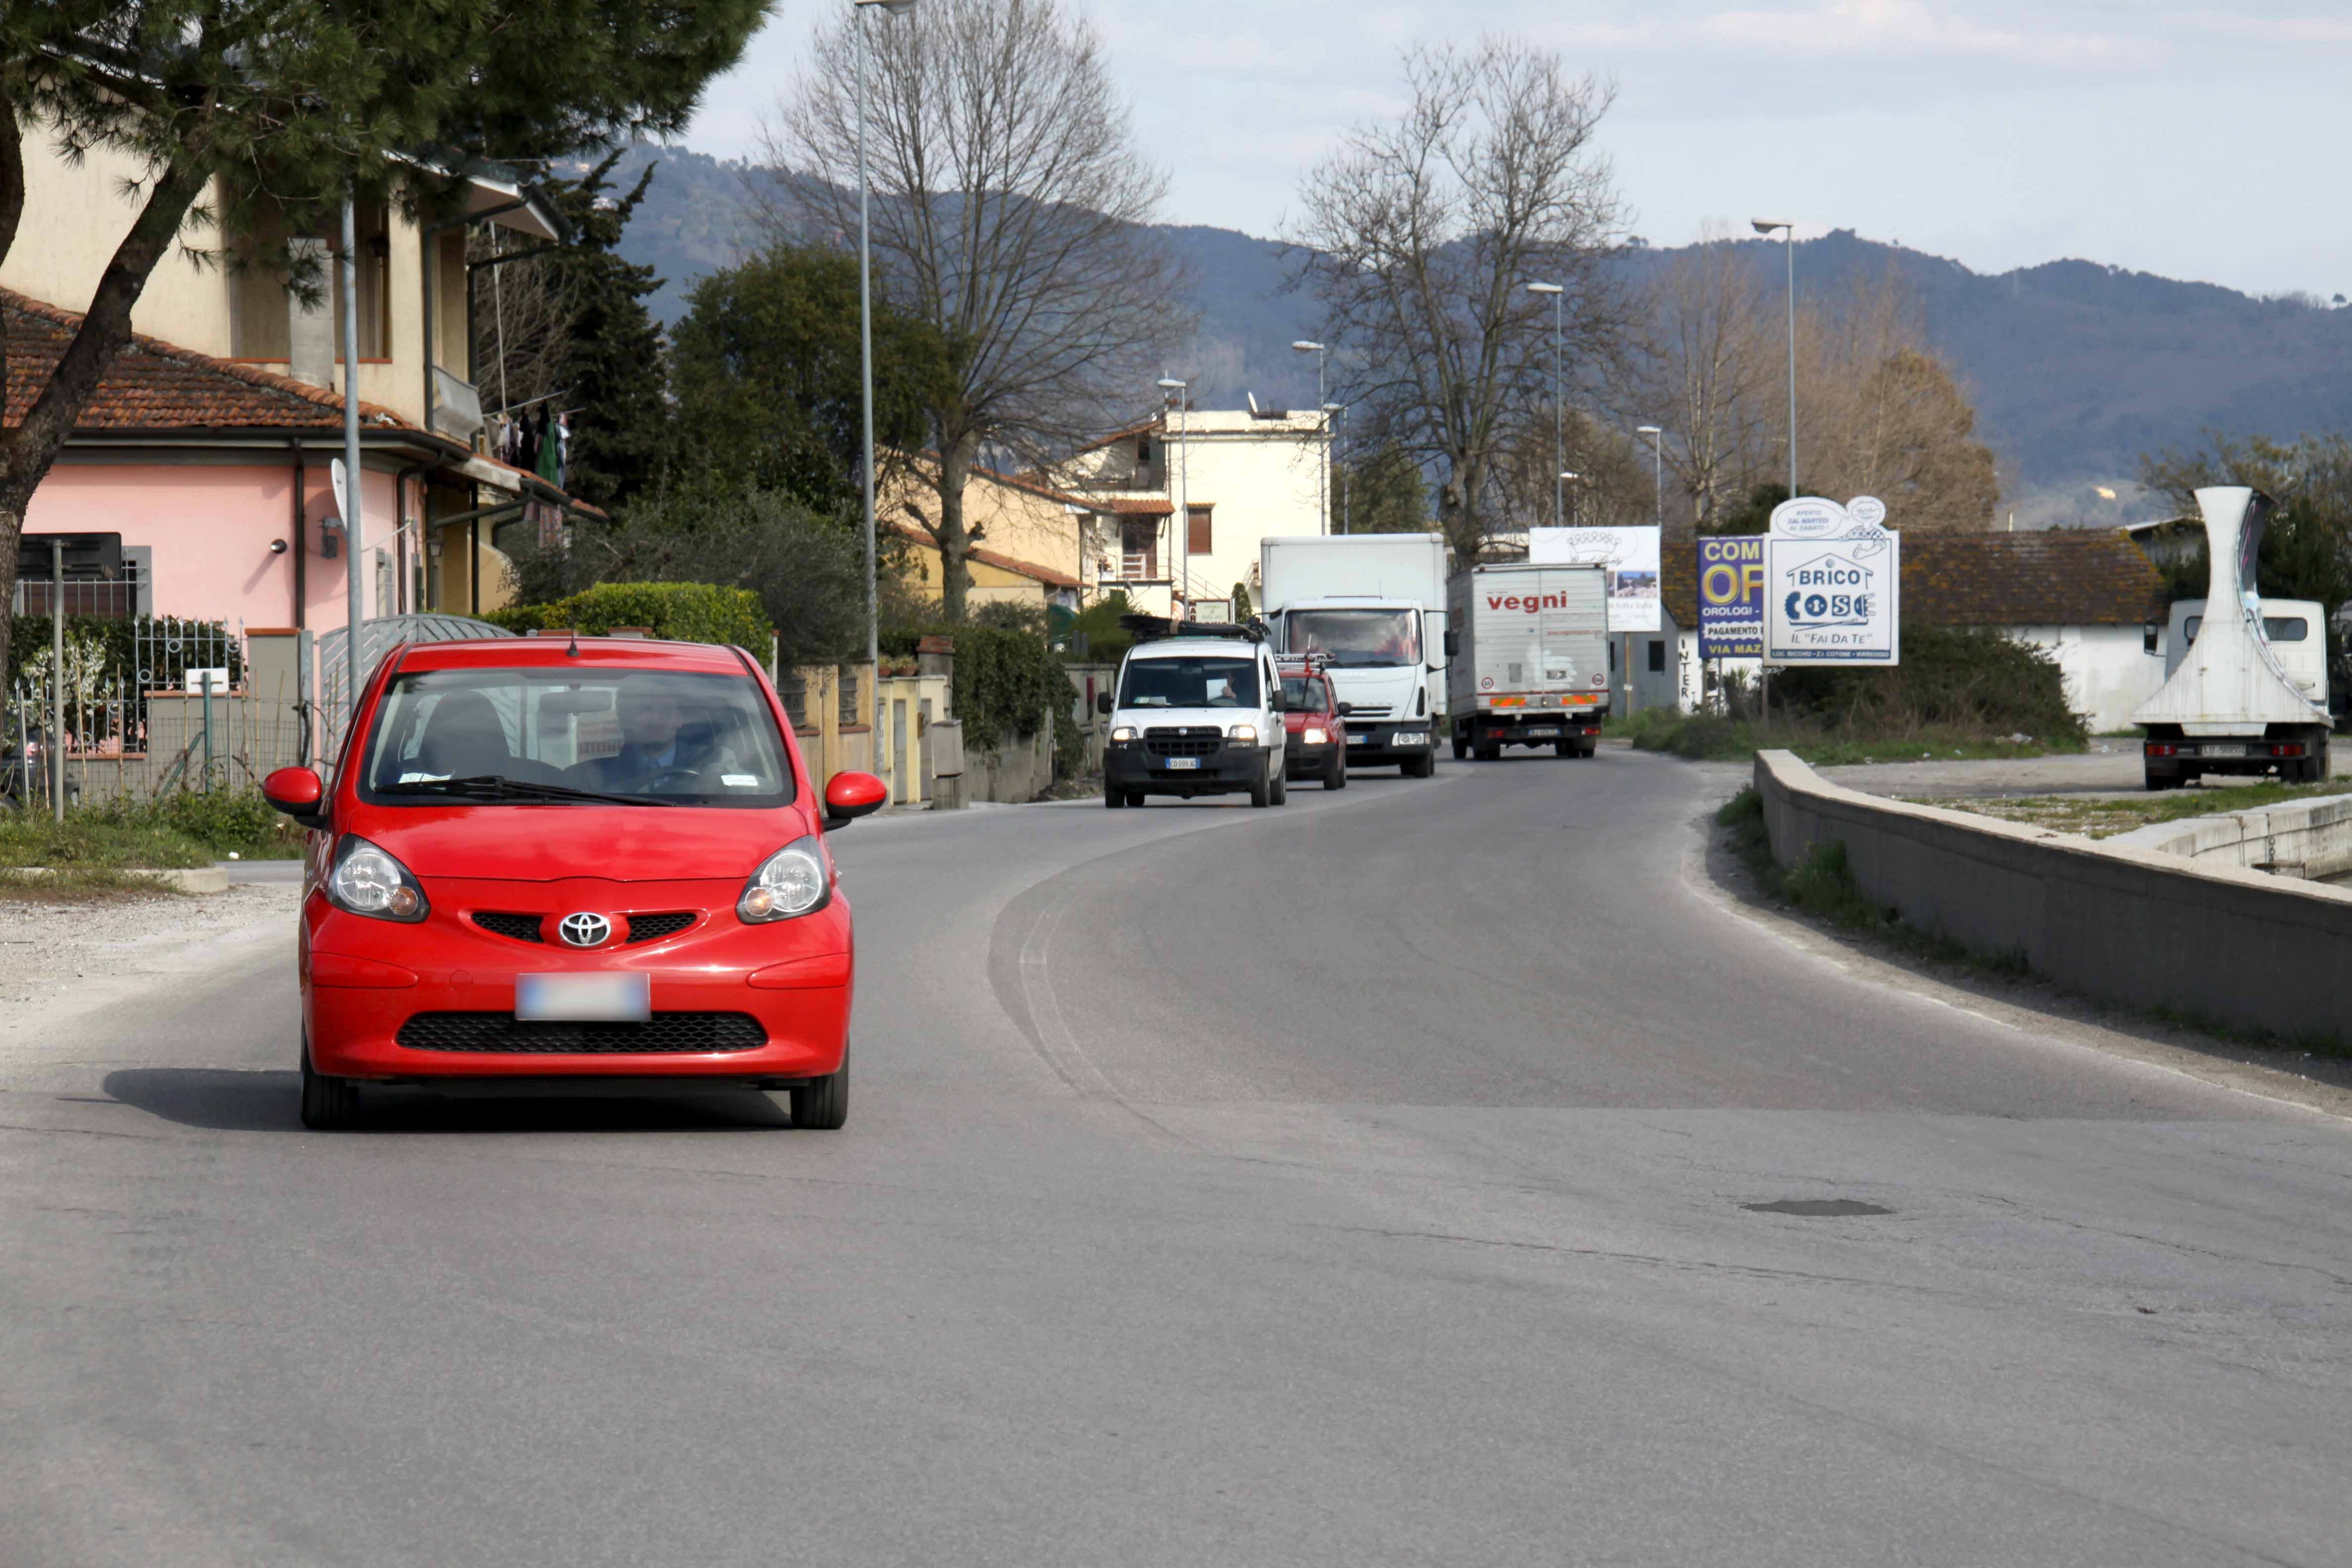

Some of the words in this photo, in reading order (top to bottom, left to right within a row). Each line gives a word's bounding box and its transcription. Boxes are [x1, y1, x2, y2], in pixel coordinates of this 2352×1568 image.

[1705, 541, 1760, 561] COM
[1799, 570, 1861, 585] BRICO
[1487, 590, 1567, 614] vegni
[1784, 591, 1876, 620] COSE
[1702, 606, 1753, 617] OROLOGI
[1708, 626, 1758, 636] PAGAMENTO
[1709, 644, 1730, 654] VIA
[1734, 644, 1762, 654] MAZ
[1679, 639, 1691, 698] INTER
